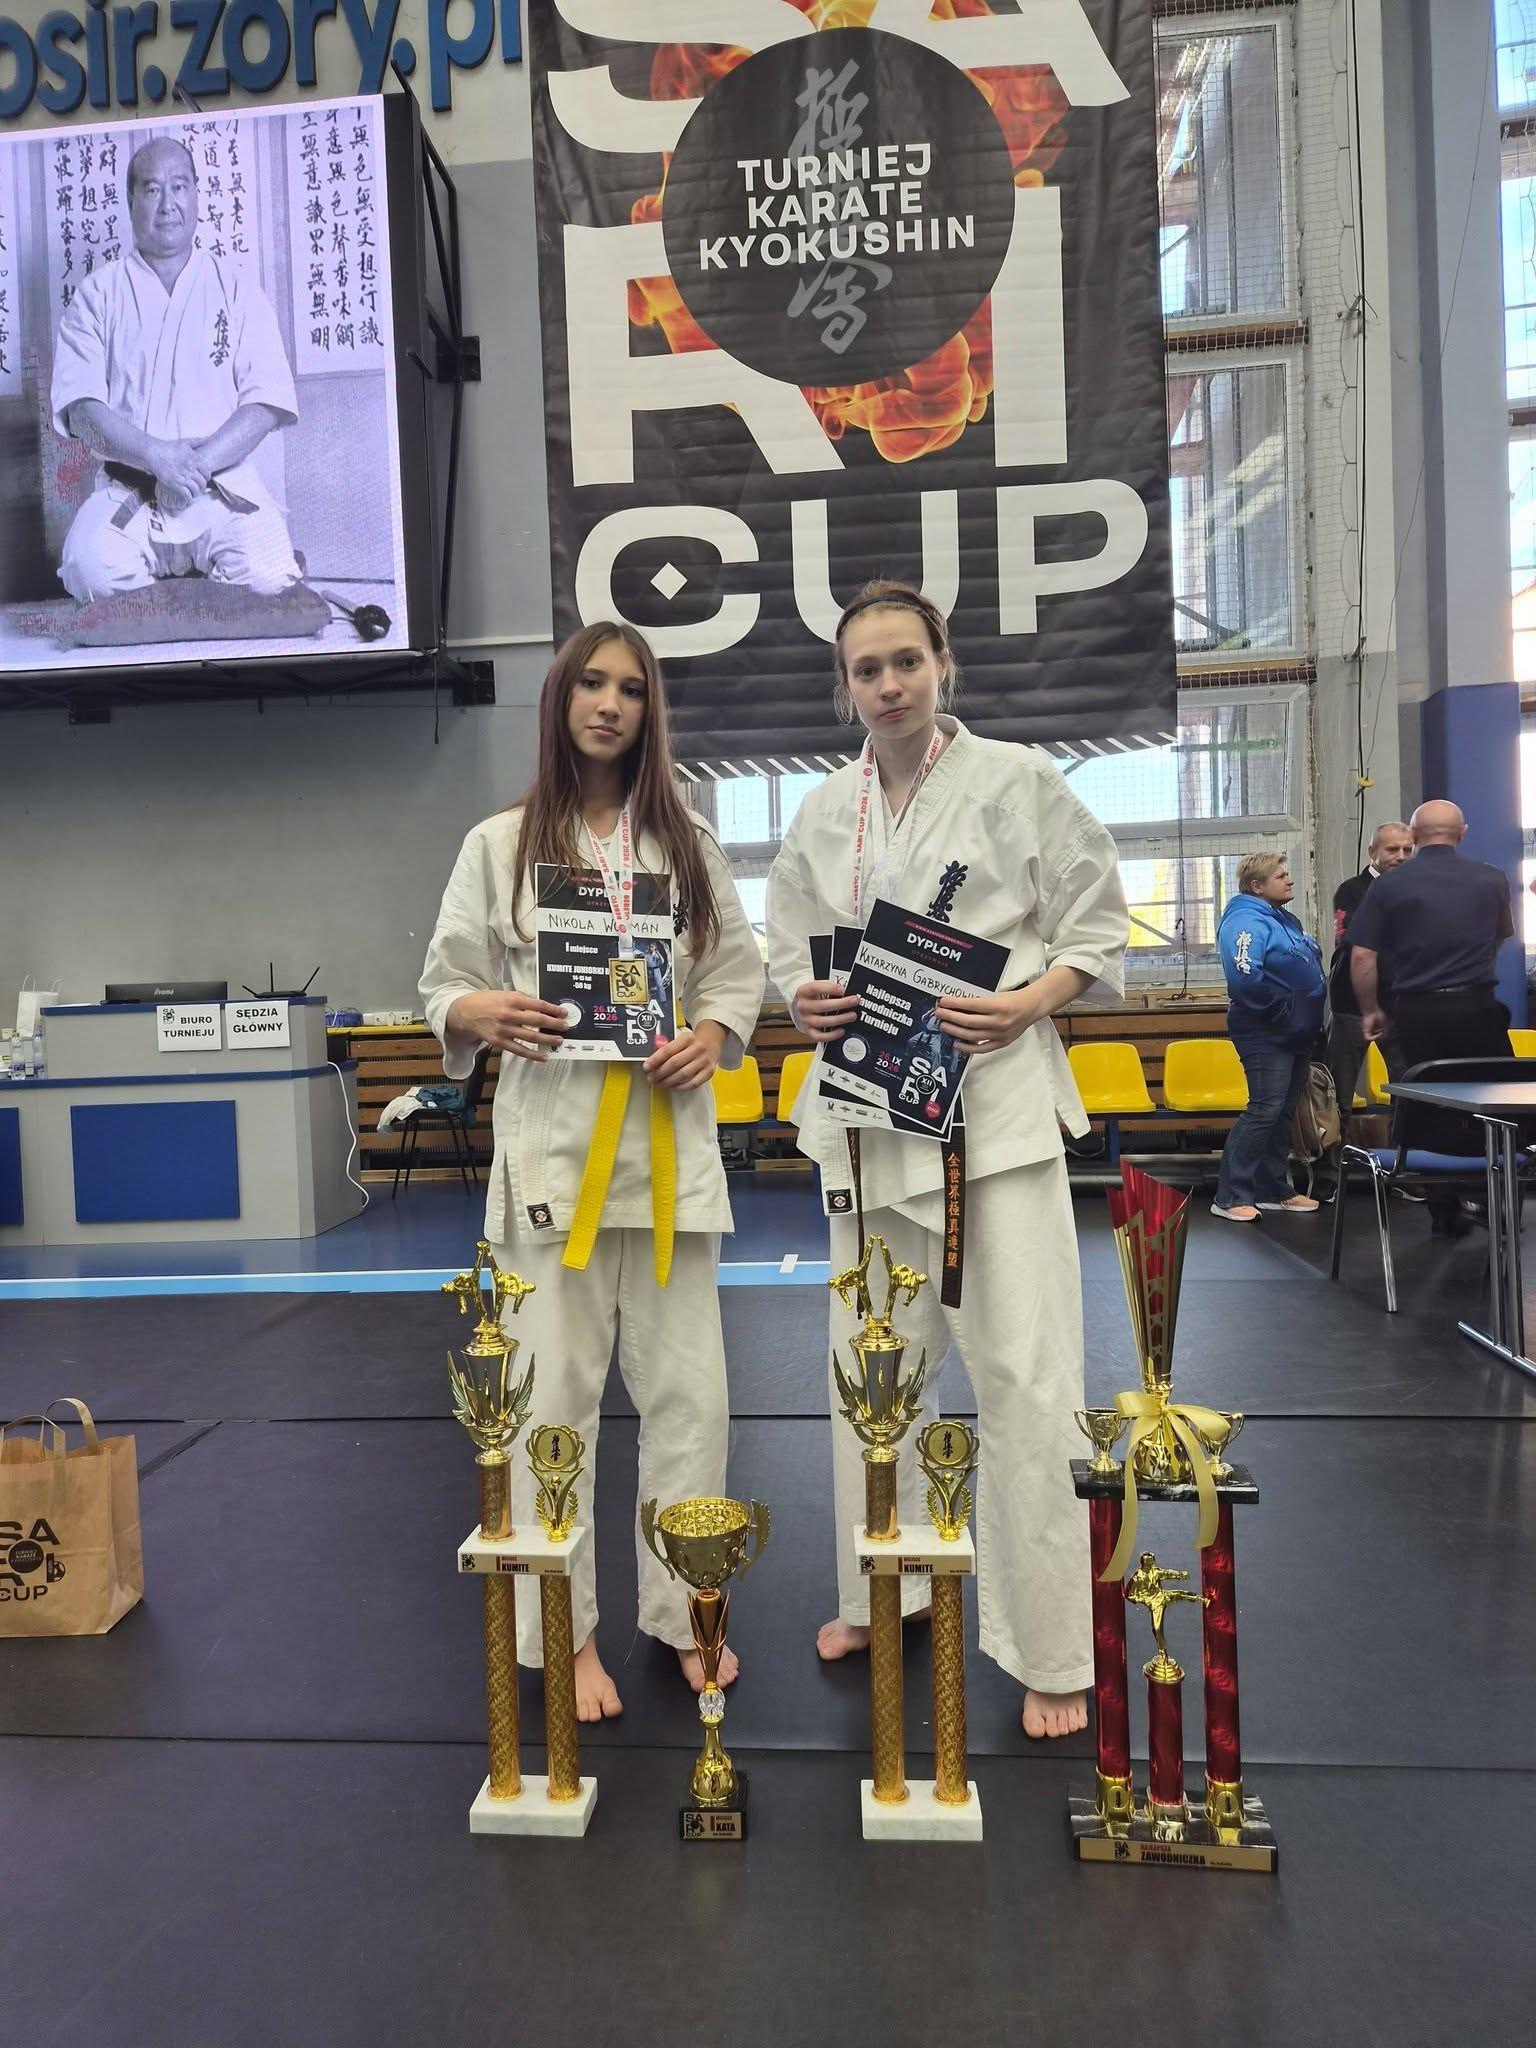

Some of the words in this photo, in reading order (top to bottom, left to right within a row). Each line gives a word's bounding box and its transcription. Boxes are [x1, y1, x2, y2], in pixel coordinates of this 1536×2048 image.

[737, 143, 931, 191] TURNIEJ
[748, 181, 922, 229] KARATE
[700, 215, 975, 270] KYOKUSHIN
[575, 479, 1148, 658] CUP
[578, 886, 610, 898] DYPL
[548, 913, 595, 931] NIKOLA
[906, 932, 962, 962] DYPLOM
[860, 946, 907, 979] KATARZYNA
[865, 983, 912, 1011] Najlepsza
[236, 1008, 278, 1019] SĘDZIA
[593, 1013, 617, 1021] 2026
[856, 993, 914, 1027] awodniczka
[181, 1016, 213, 1024] BIURO
[233, 1022, 283, 1033] GŁÓWNY
[859, 1010, 900, 1036] Turnieju
[164, 1029, 215, 1037] TURNIEJU
[908, 1056, 948, 1088] SA
[502, 1563, 529, 1572] KUMITE
[904, 1564, 933, 1573] KUMITE
[0, 1585, 48, 1601] CUP
[716, 1823, 735, 1831] KATA
[1141, 1851, 1206, 1865] ZAWODNICZKA
